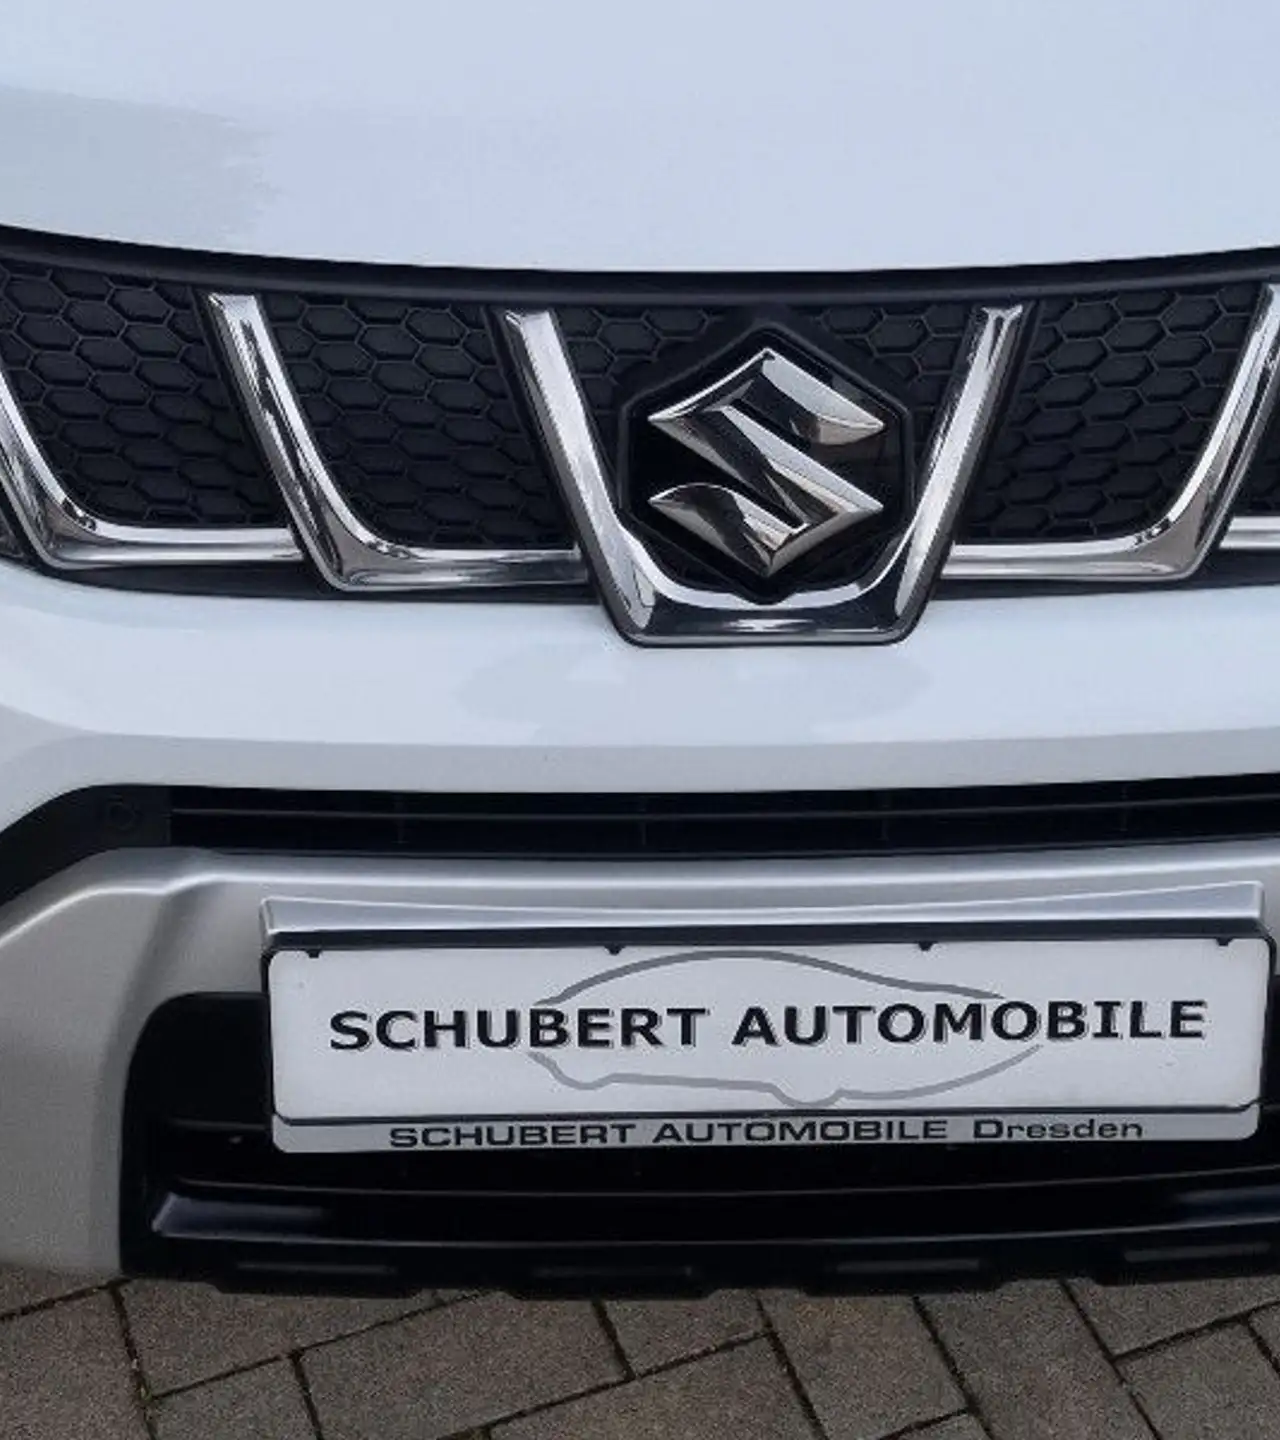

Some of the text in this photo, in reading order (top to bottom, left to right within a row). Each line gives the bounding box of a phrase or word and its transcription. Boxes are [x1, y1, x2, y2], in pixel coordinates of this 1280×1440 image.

[329, 1000, 1207, 1050] SCHUBERT AUTOMOBILE
[389, 1117, 1144, 1148] SCHUBERT AUTOMOBILE Dresden
